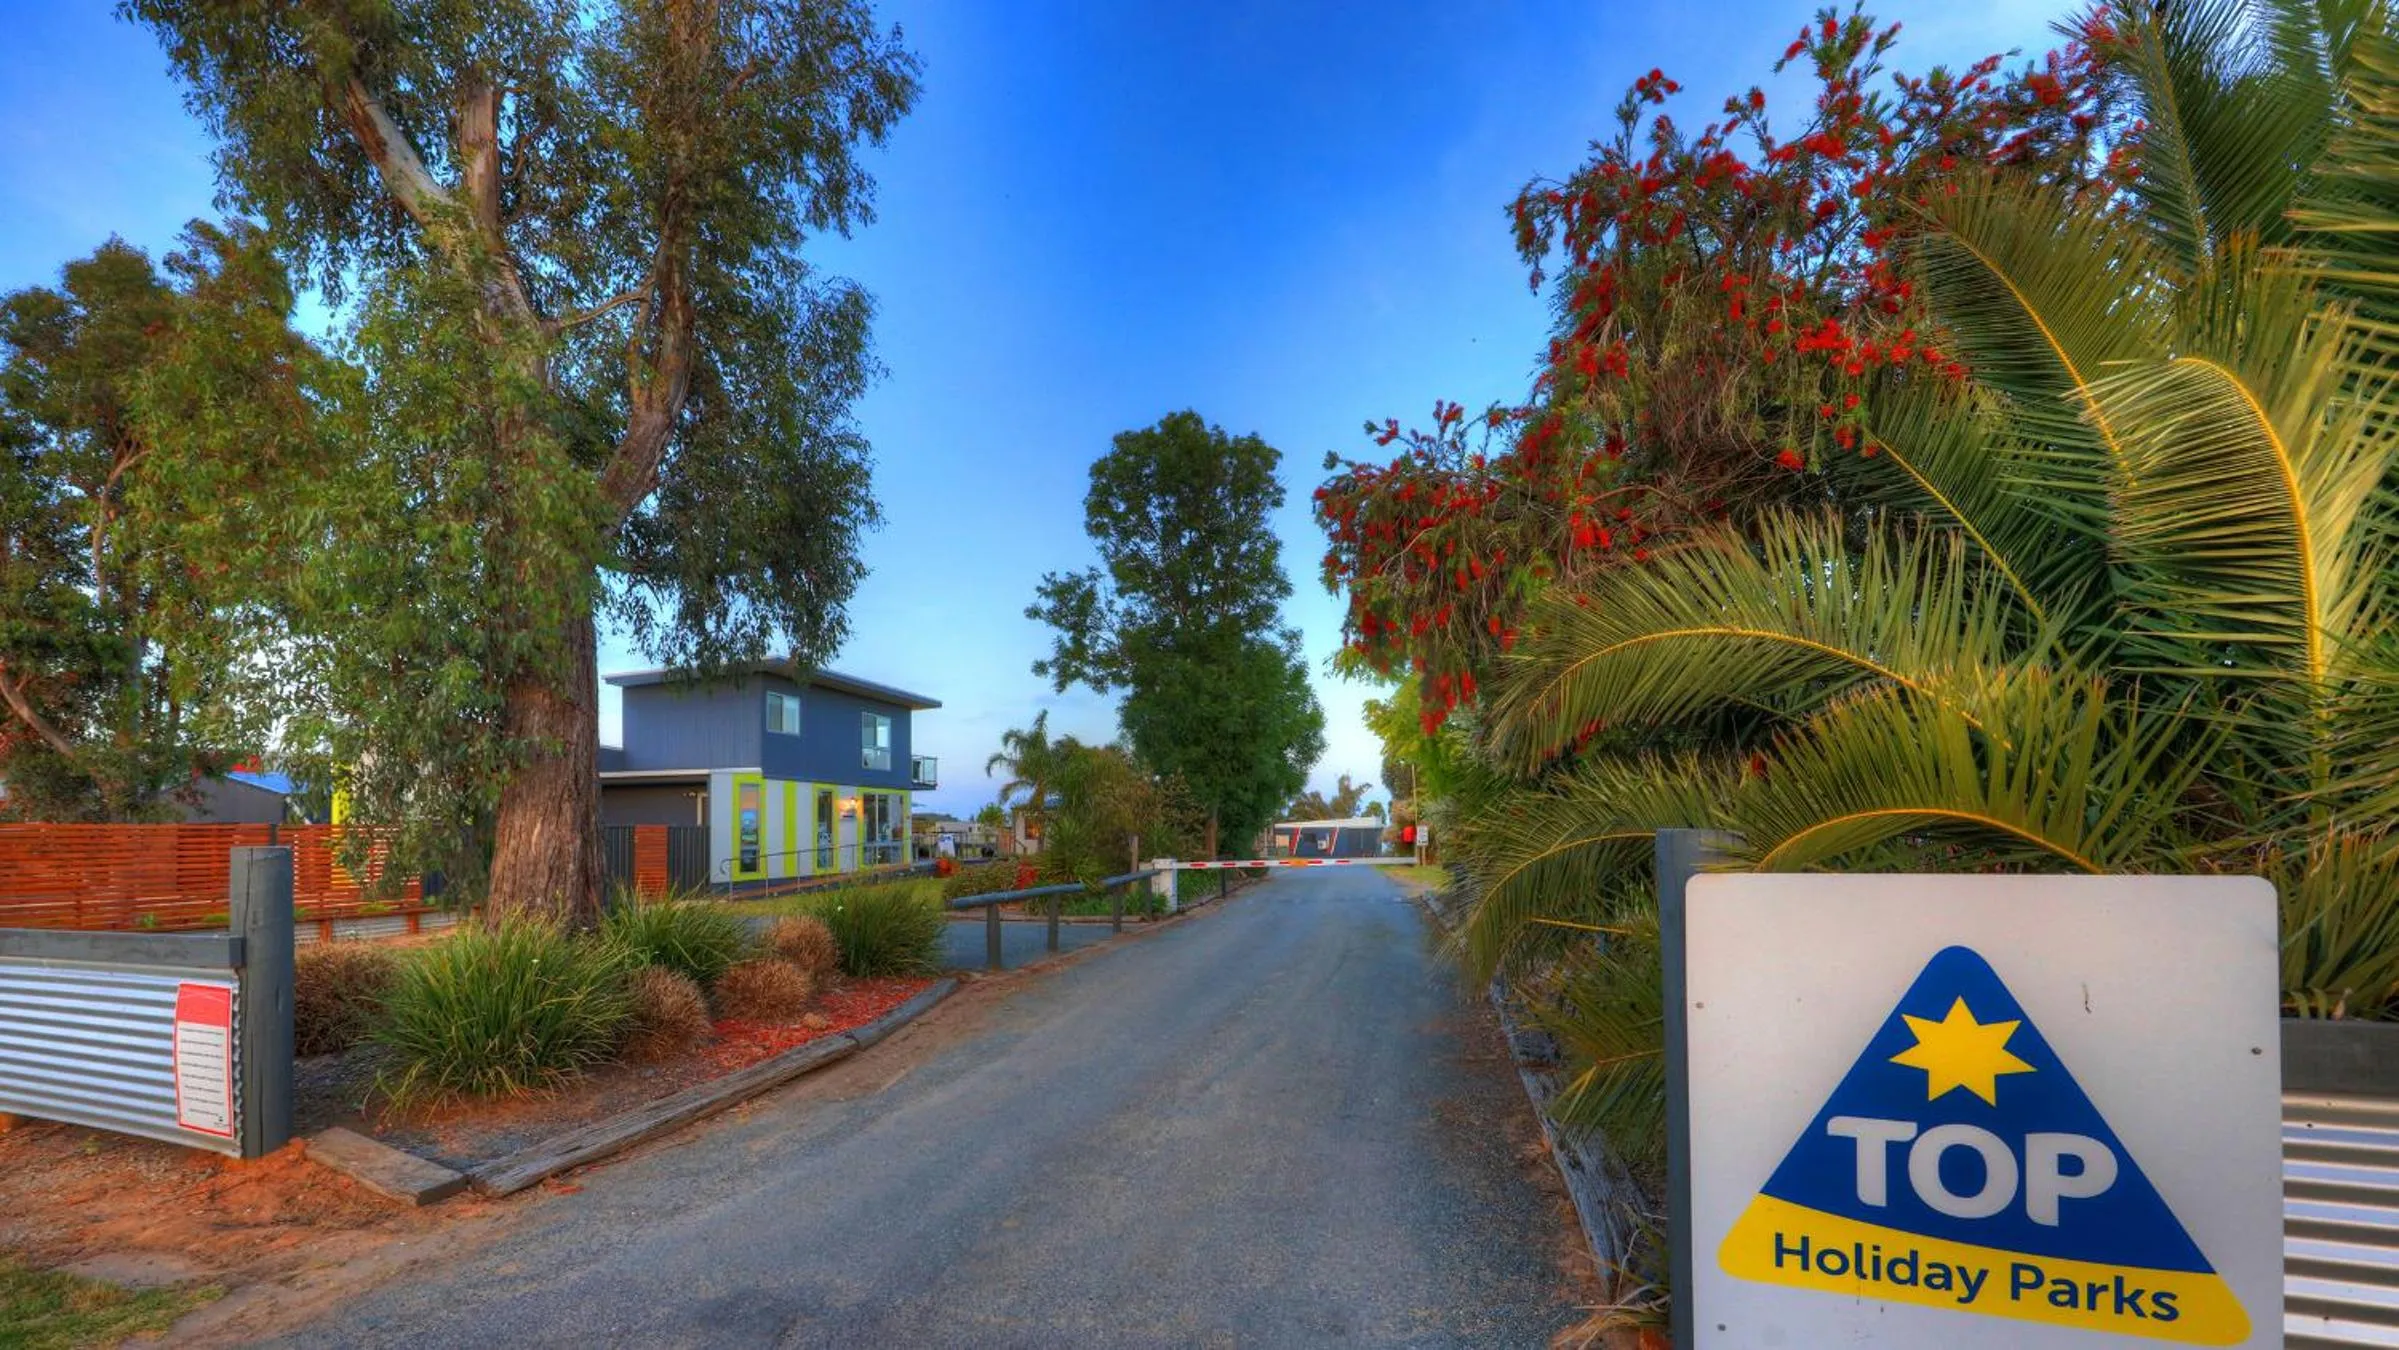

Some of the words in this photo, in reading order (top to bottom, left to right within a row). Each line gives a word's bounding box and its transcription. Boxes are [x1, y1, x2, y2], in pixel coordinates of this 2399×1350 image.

[1827, 1115, 2118, 1226] TOP
[1774, 1232, 1989, 1304] Holiday
[2010, 1262, 2180, 1322] Parks
